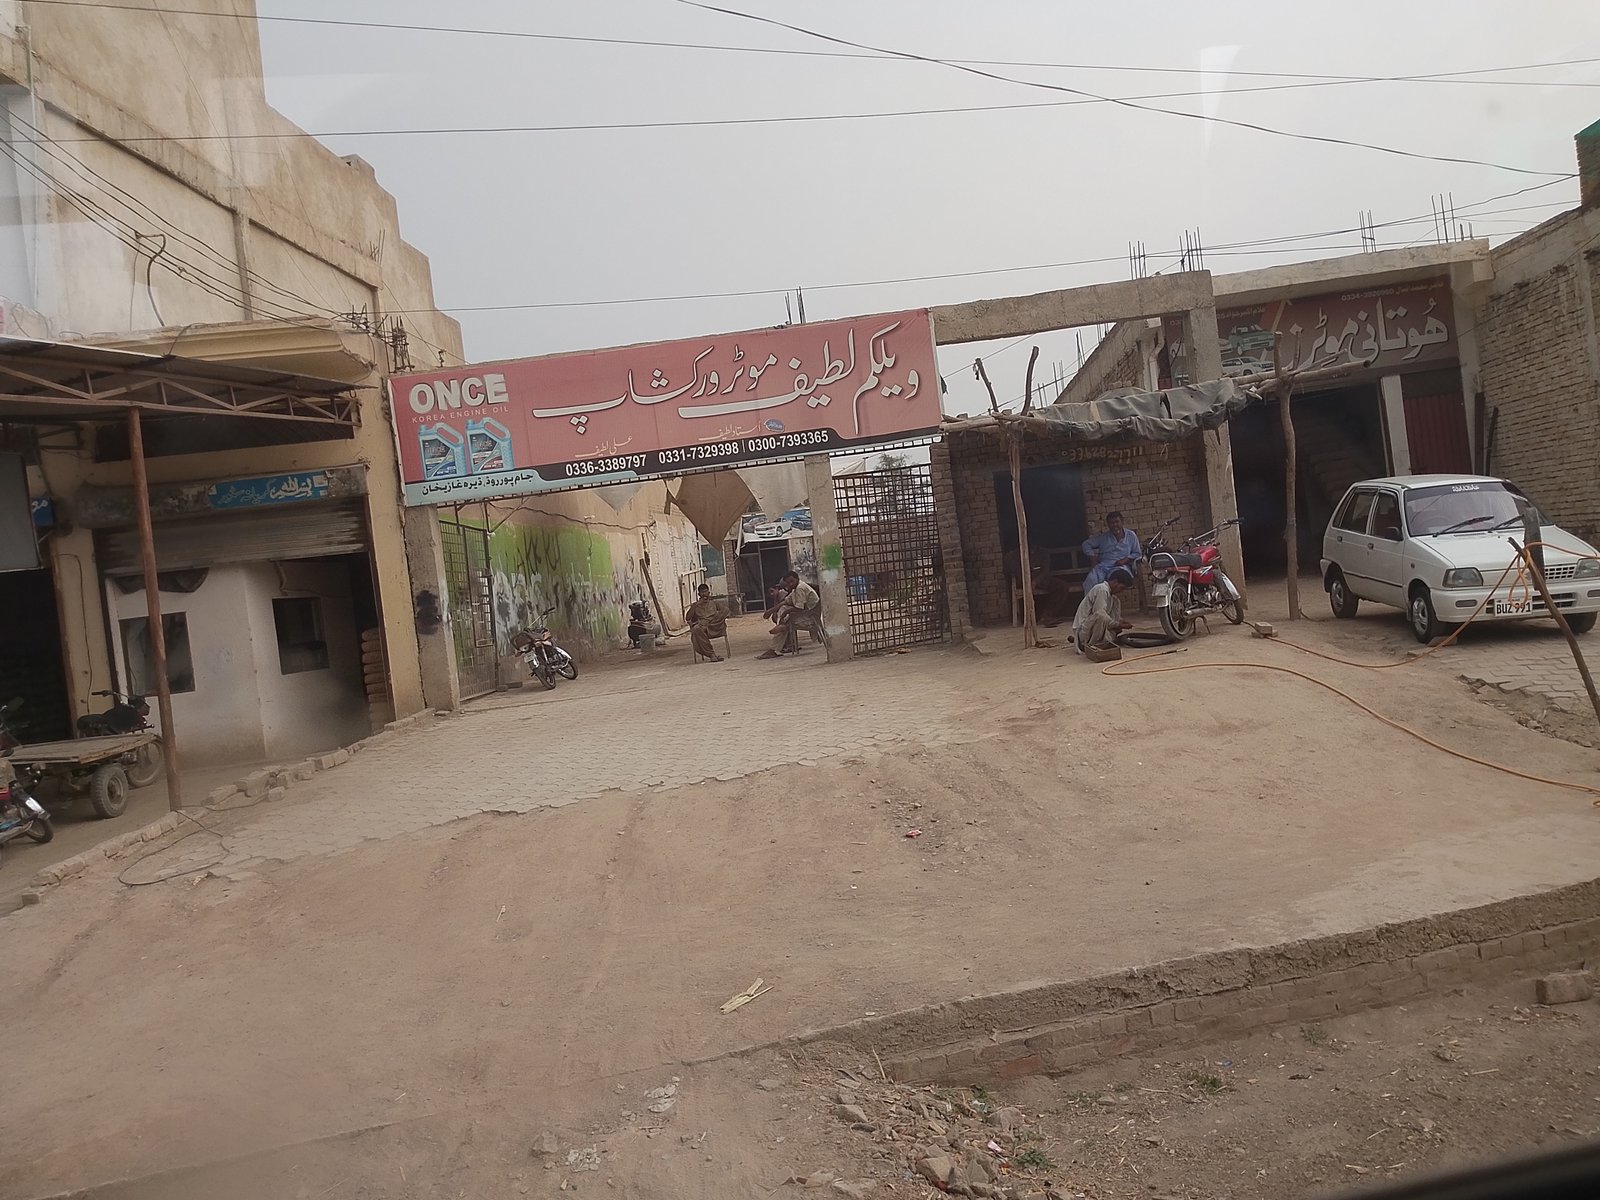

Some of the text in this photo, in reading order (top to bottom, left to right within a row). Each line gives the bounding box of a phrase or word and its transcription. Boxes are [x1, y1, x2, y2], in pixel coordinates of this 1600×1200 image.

[678, 328, 856, 419] لطیف
[722, 344, 778, 394] موٹر
[853, 322, 921, 434] ویلکم
[409, 374, 509, 414] ONCE
[412, 414, 446, 423] KOREA
[450, 408, 488, 418] ENGINE
[575, 436, 633, 457] علی لطیف
[699, 424, 733, 440] لطیف
[565, 430, 829, 477] 0336-3389797 0331-7329398 0300-7393365
[464, 477, 482, 489] ڈیرہ
[1496, 603, 1513, 614] BUZ
